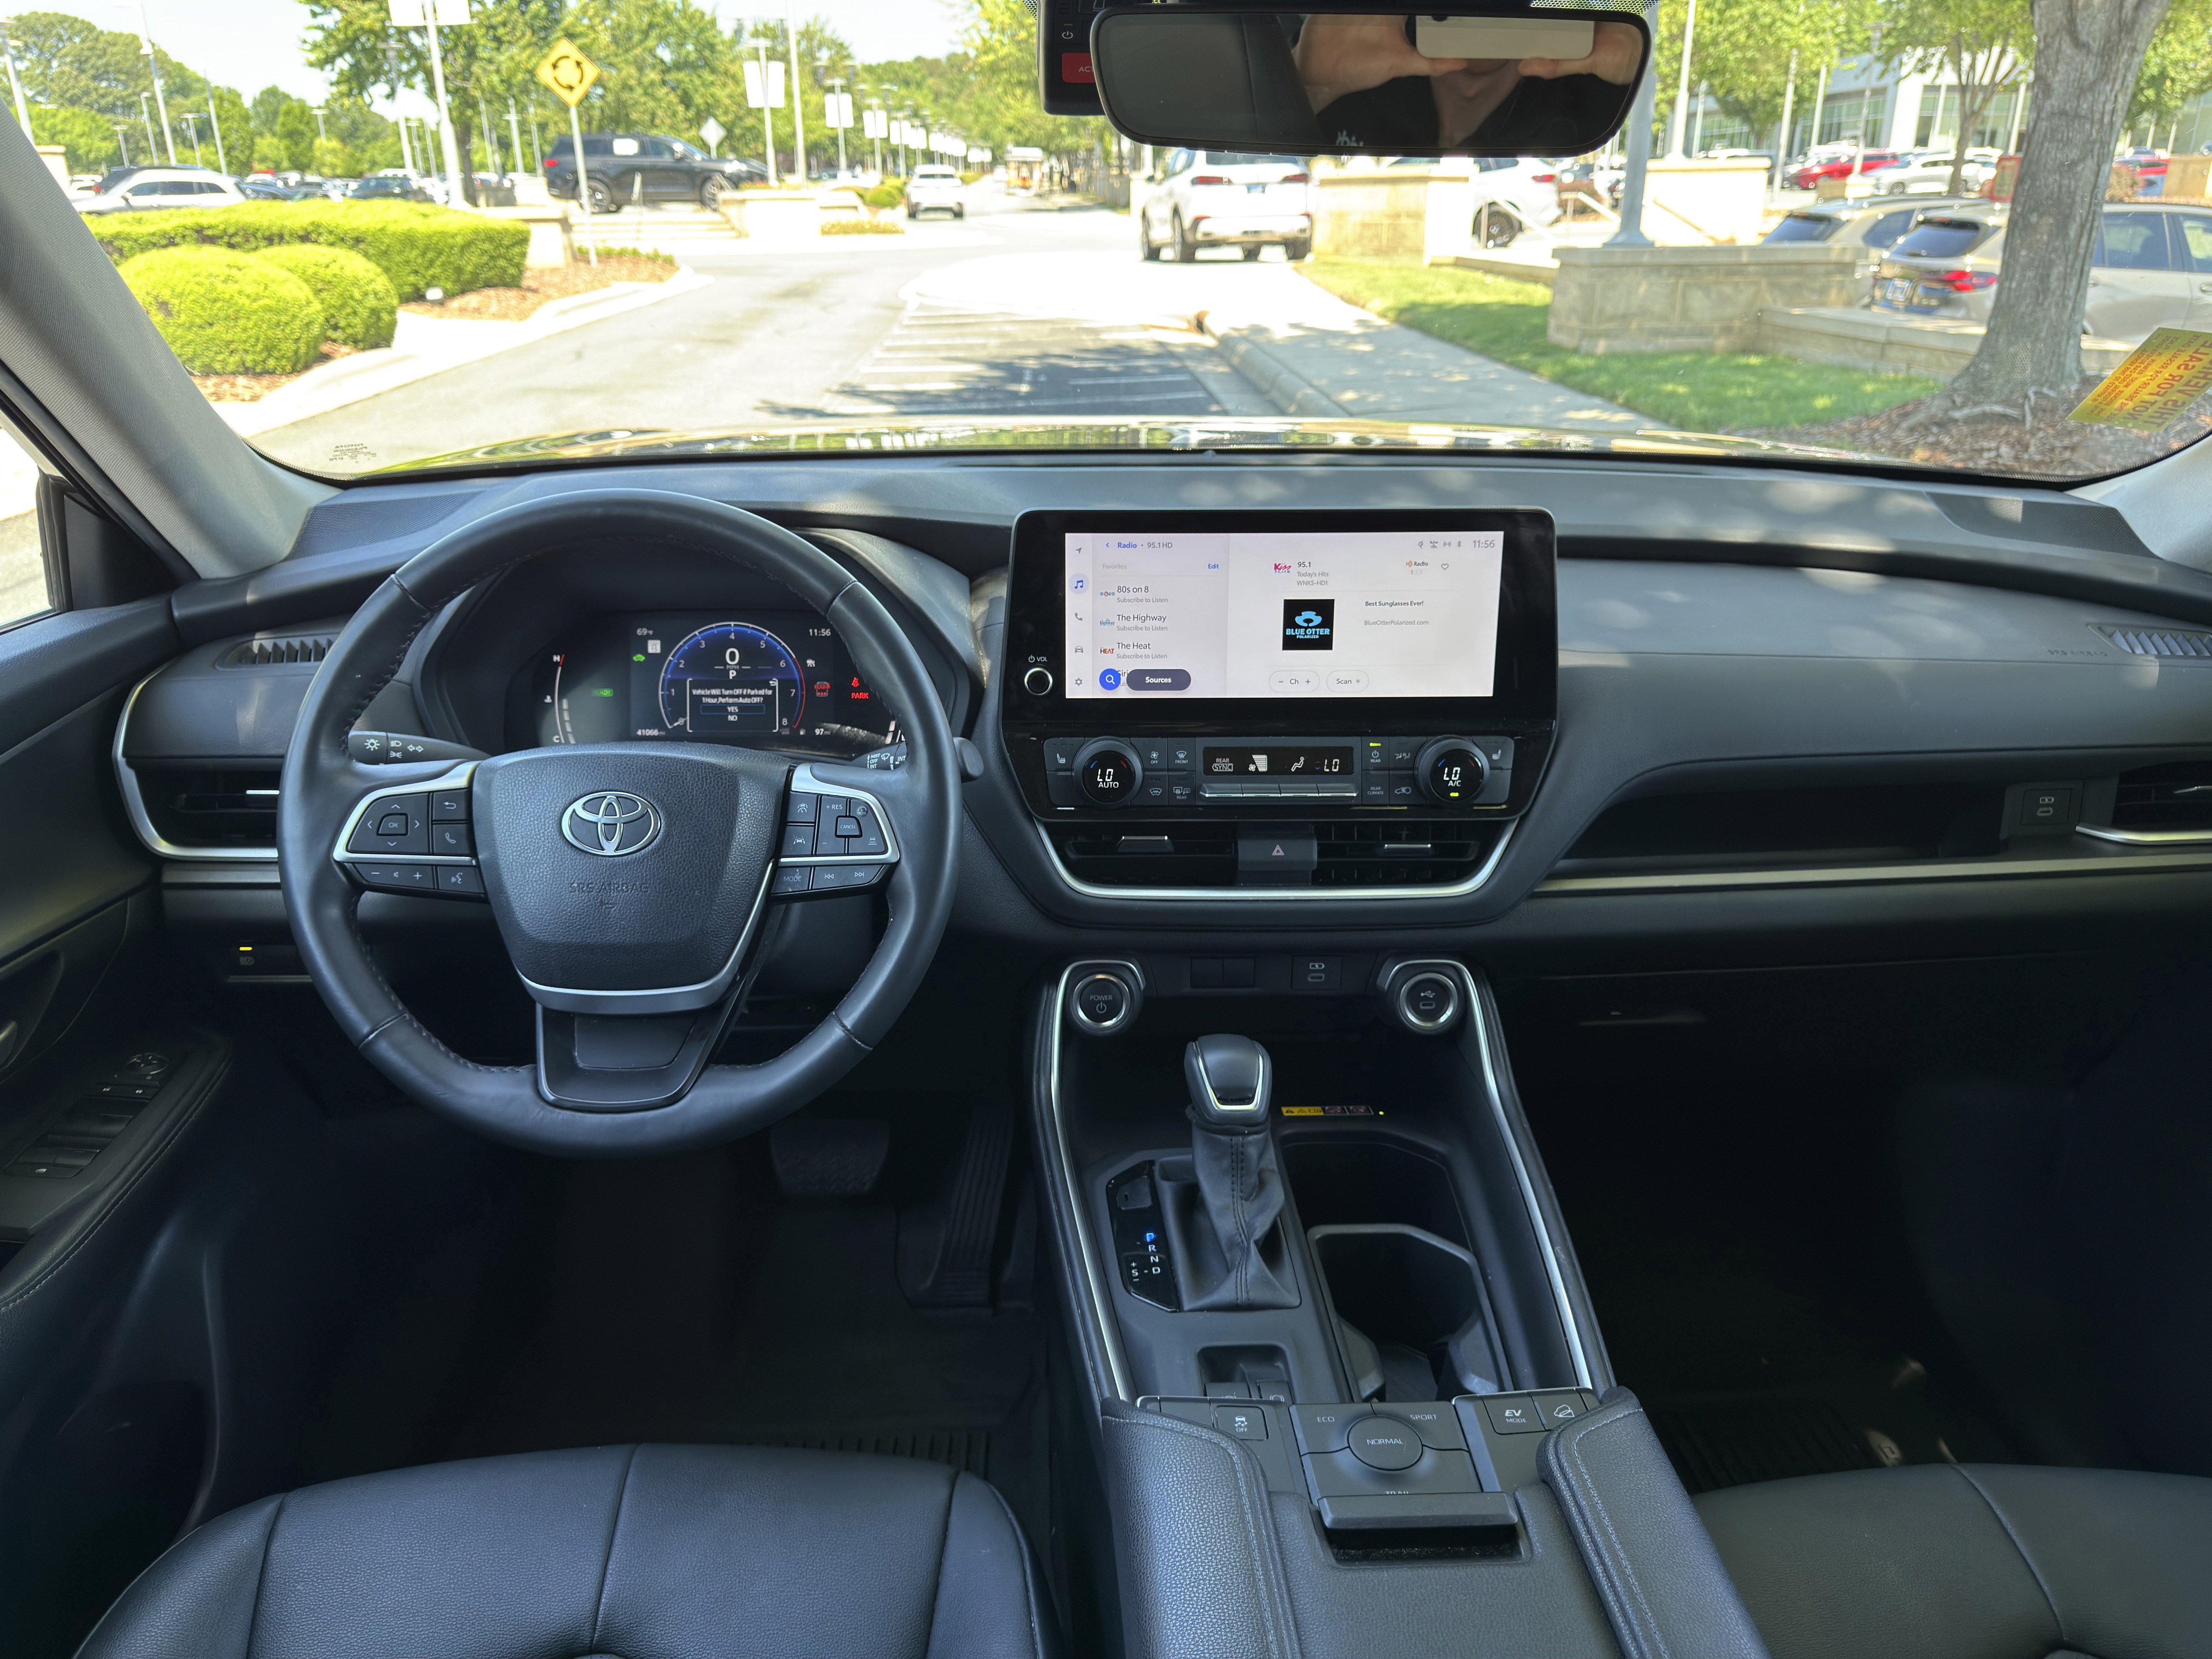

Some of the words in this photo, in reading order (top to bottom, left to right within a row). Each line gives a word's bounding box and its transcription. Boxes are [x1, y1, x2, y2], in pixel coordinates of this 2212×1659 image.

[1473, 540, 1495, 548] 11:56
[1133, 614, 1167, 623] Highway
[809, 628, 831, 636] 11:56
[725, 648, 740, 665] 0
[729, 670, 737, 679] P
[1146, 1233, 1155, 1242] P
[1132, 1269, 1138, 1277] S
[1152, 1267, 1161, 1275] D
